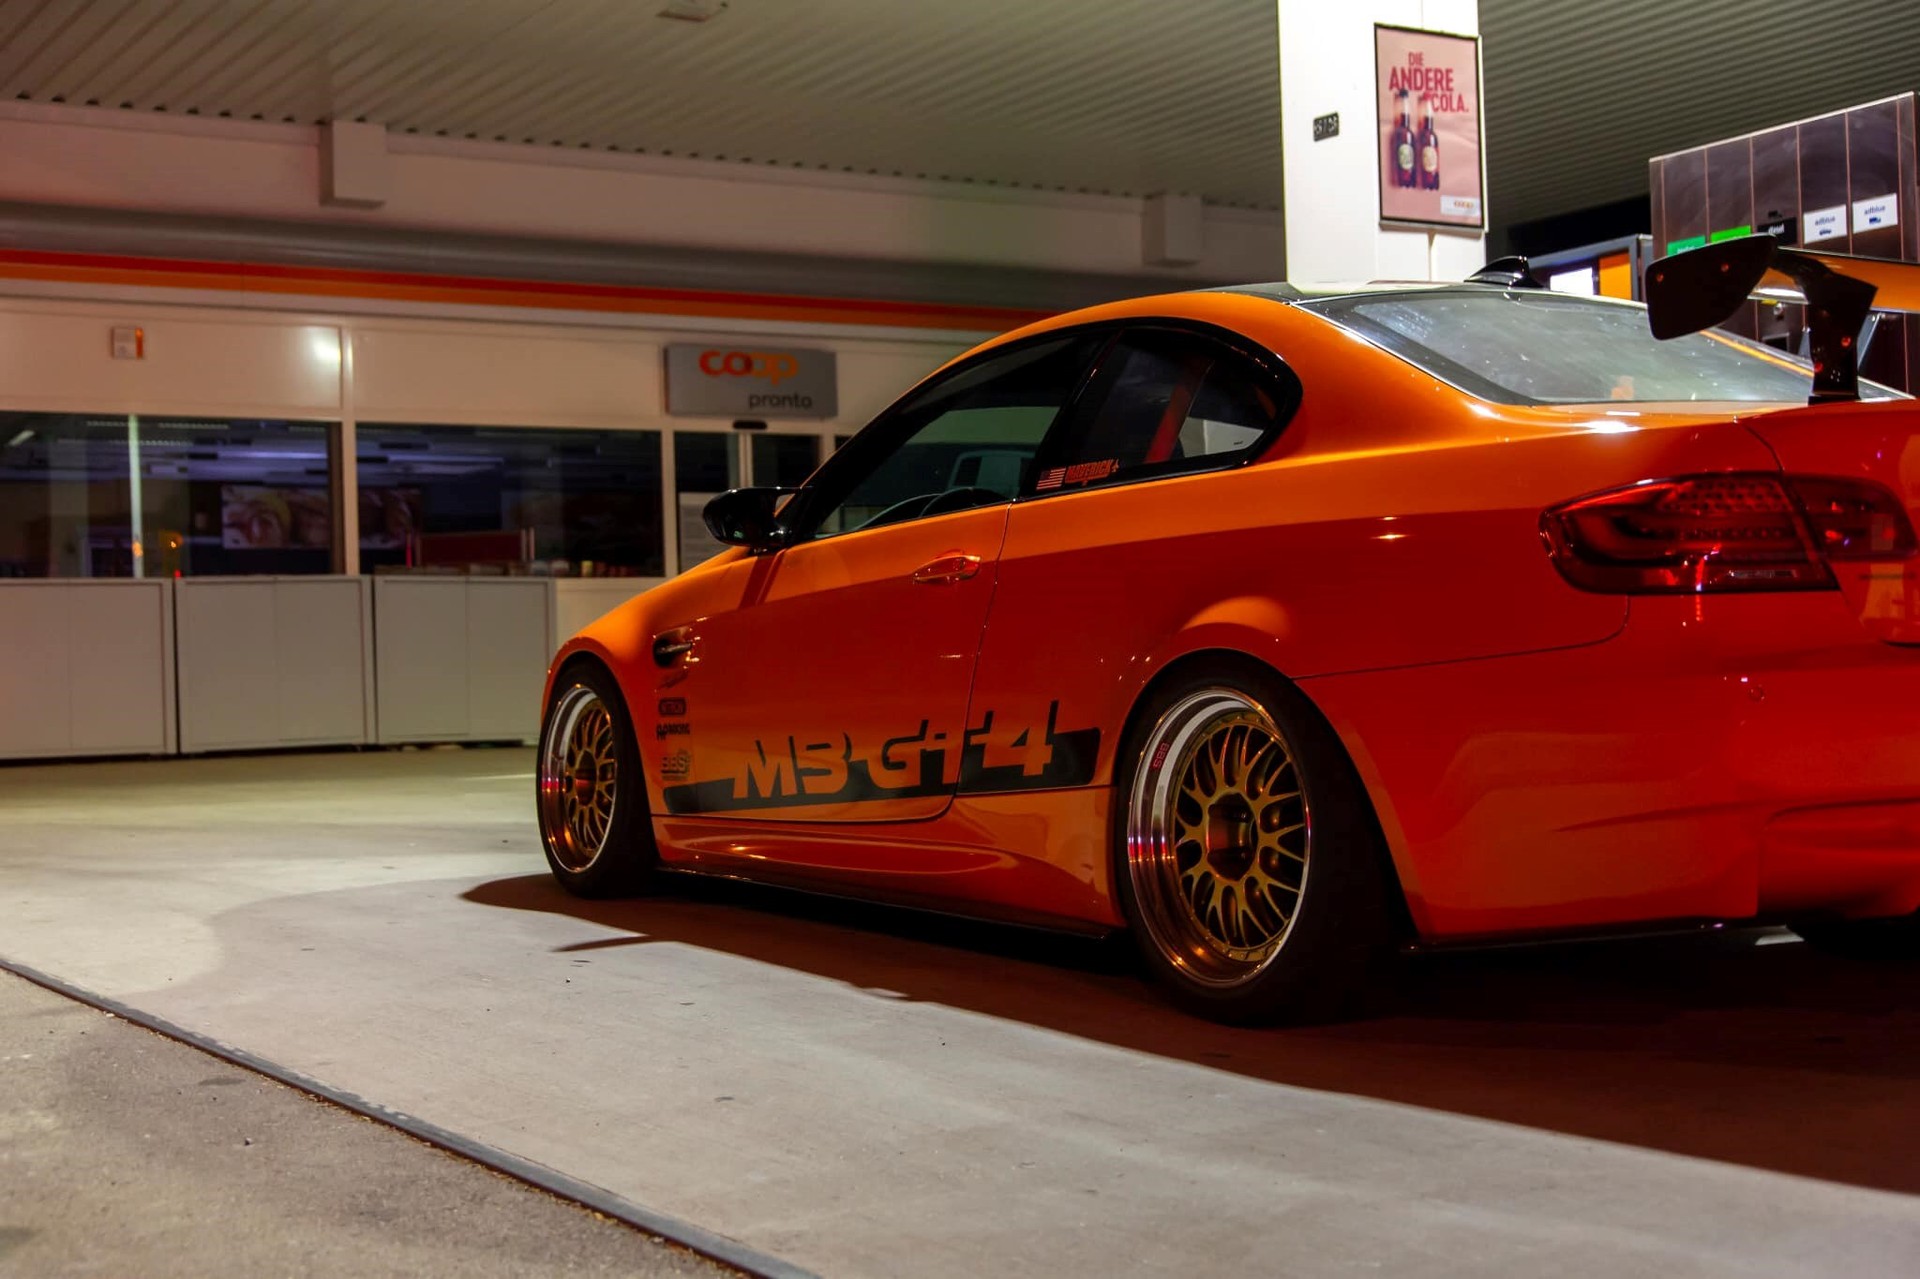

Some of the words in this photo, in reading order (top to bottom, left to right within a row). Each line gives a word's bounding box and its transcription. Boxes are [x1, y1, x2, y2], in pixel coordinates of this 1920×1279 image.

[1408, 52, 1424, 66] DIE
[1389, 67, 1454, 91] ANDERE
[1431, 93, 1469, 113] COLA.
[700, 350, 798, 385] coop
[749, 393, 812, 409] pronto
